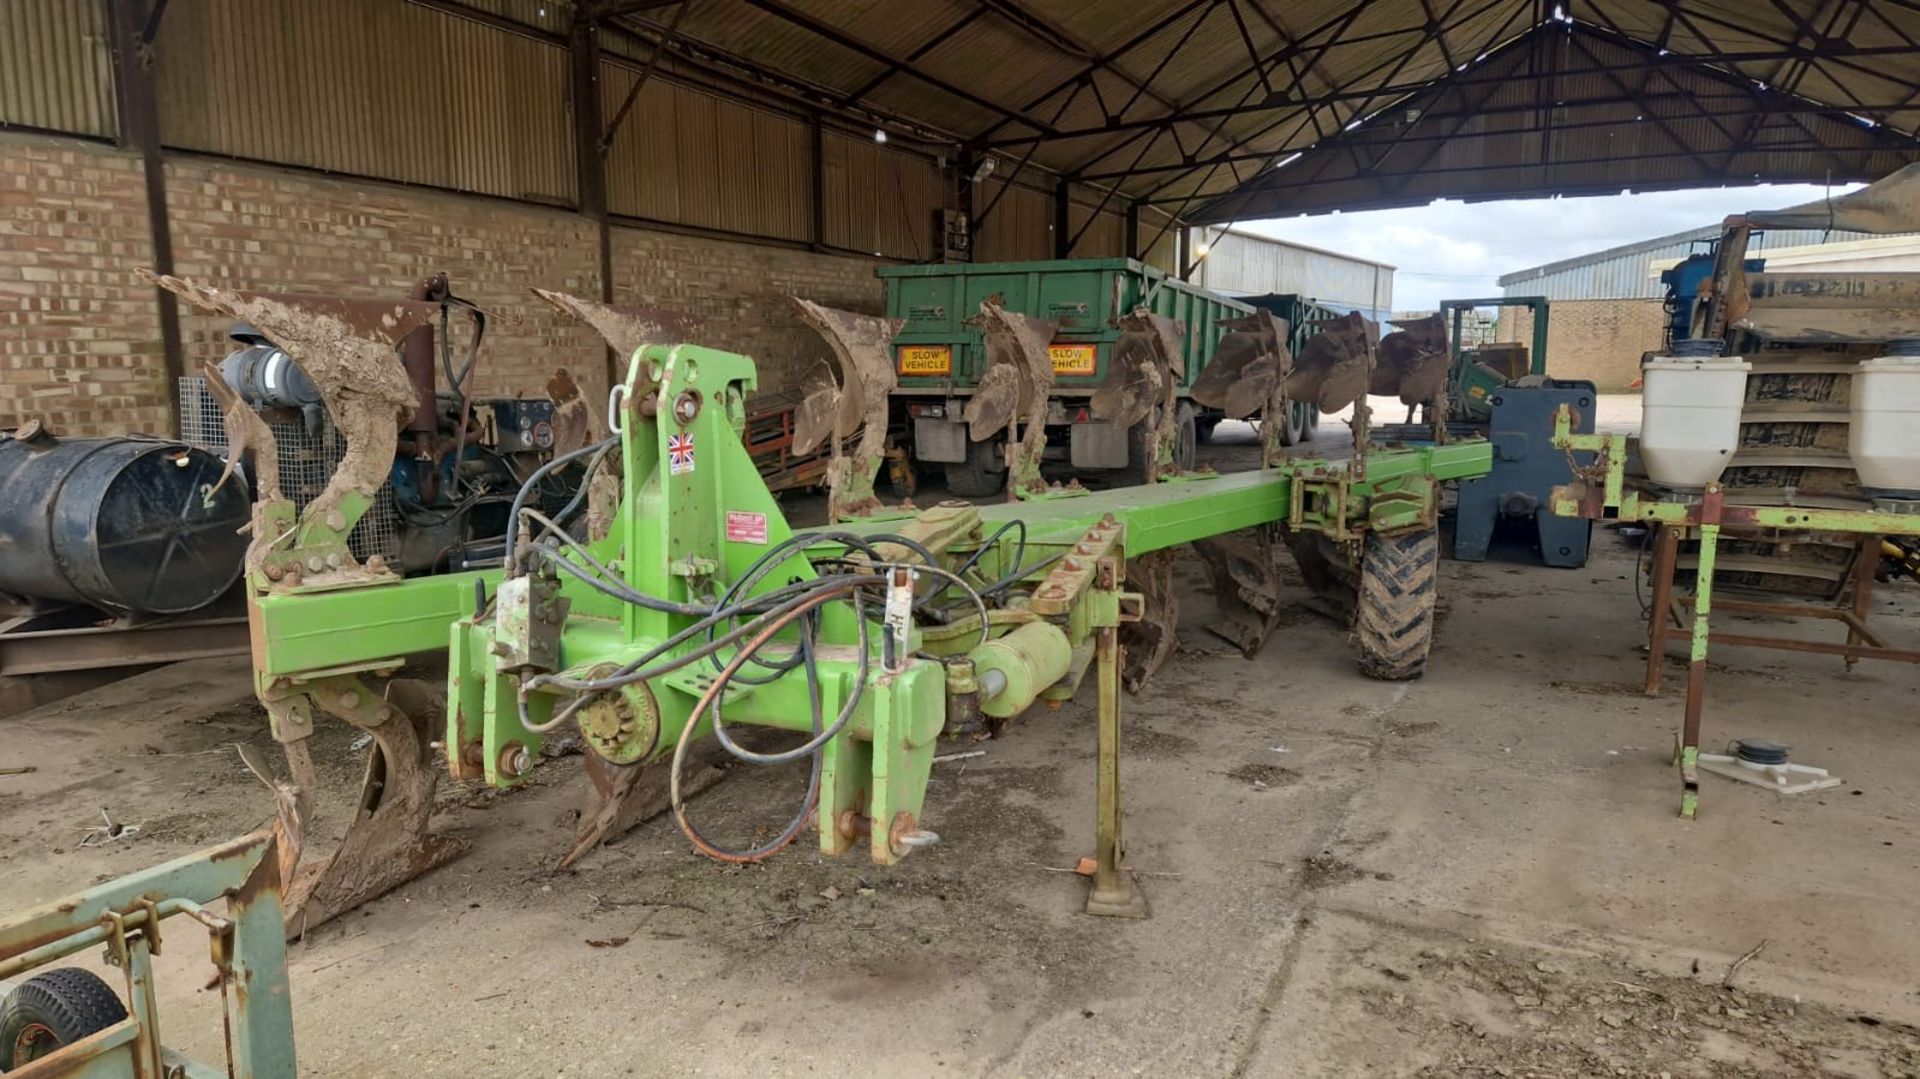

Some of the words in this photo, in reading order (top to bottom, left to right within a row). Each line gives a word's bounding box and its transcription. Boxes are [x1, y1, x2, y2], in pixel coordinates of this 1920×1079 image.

[912, 351, 940, 360] SLOW
[1052, 349, 1082, 359] SLOW
[905, 360, 946, 369] VEHICLE
[1051, 359, 1091, 369] EHICLE
[200, 483, 216, 509] 2
